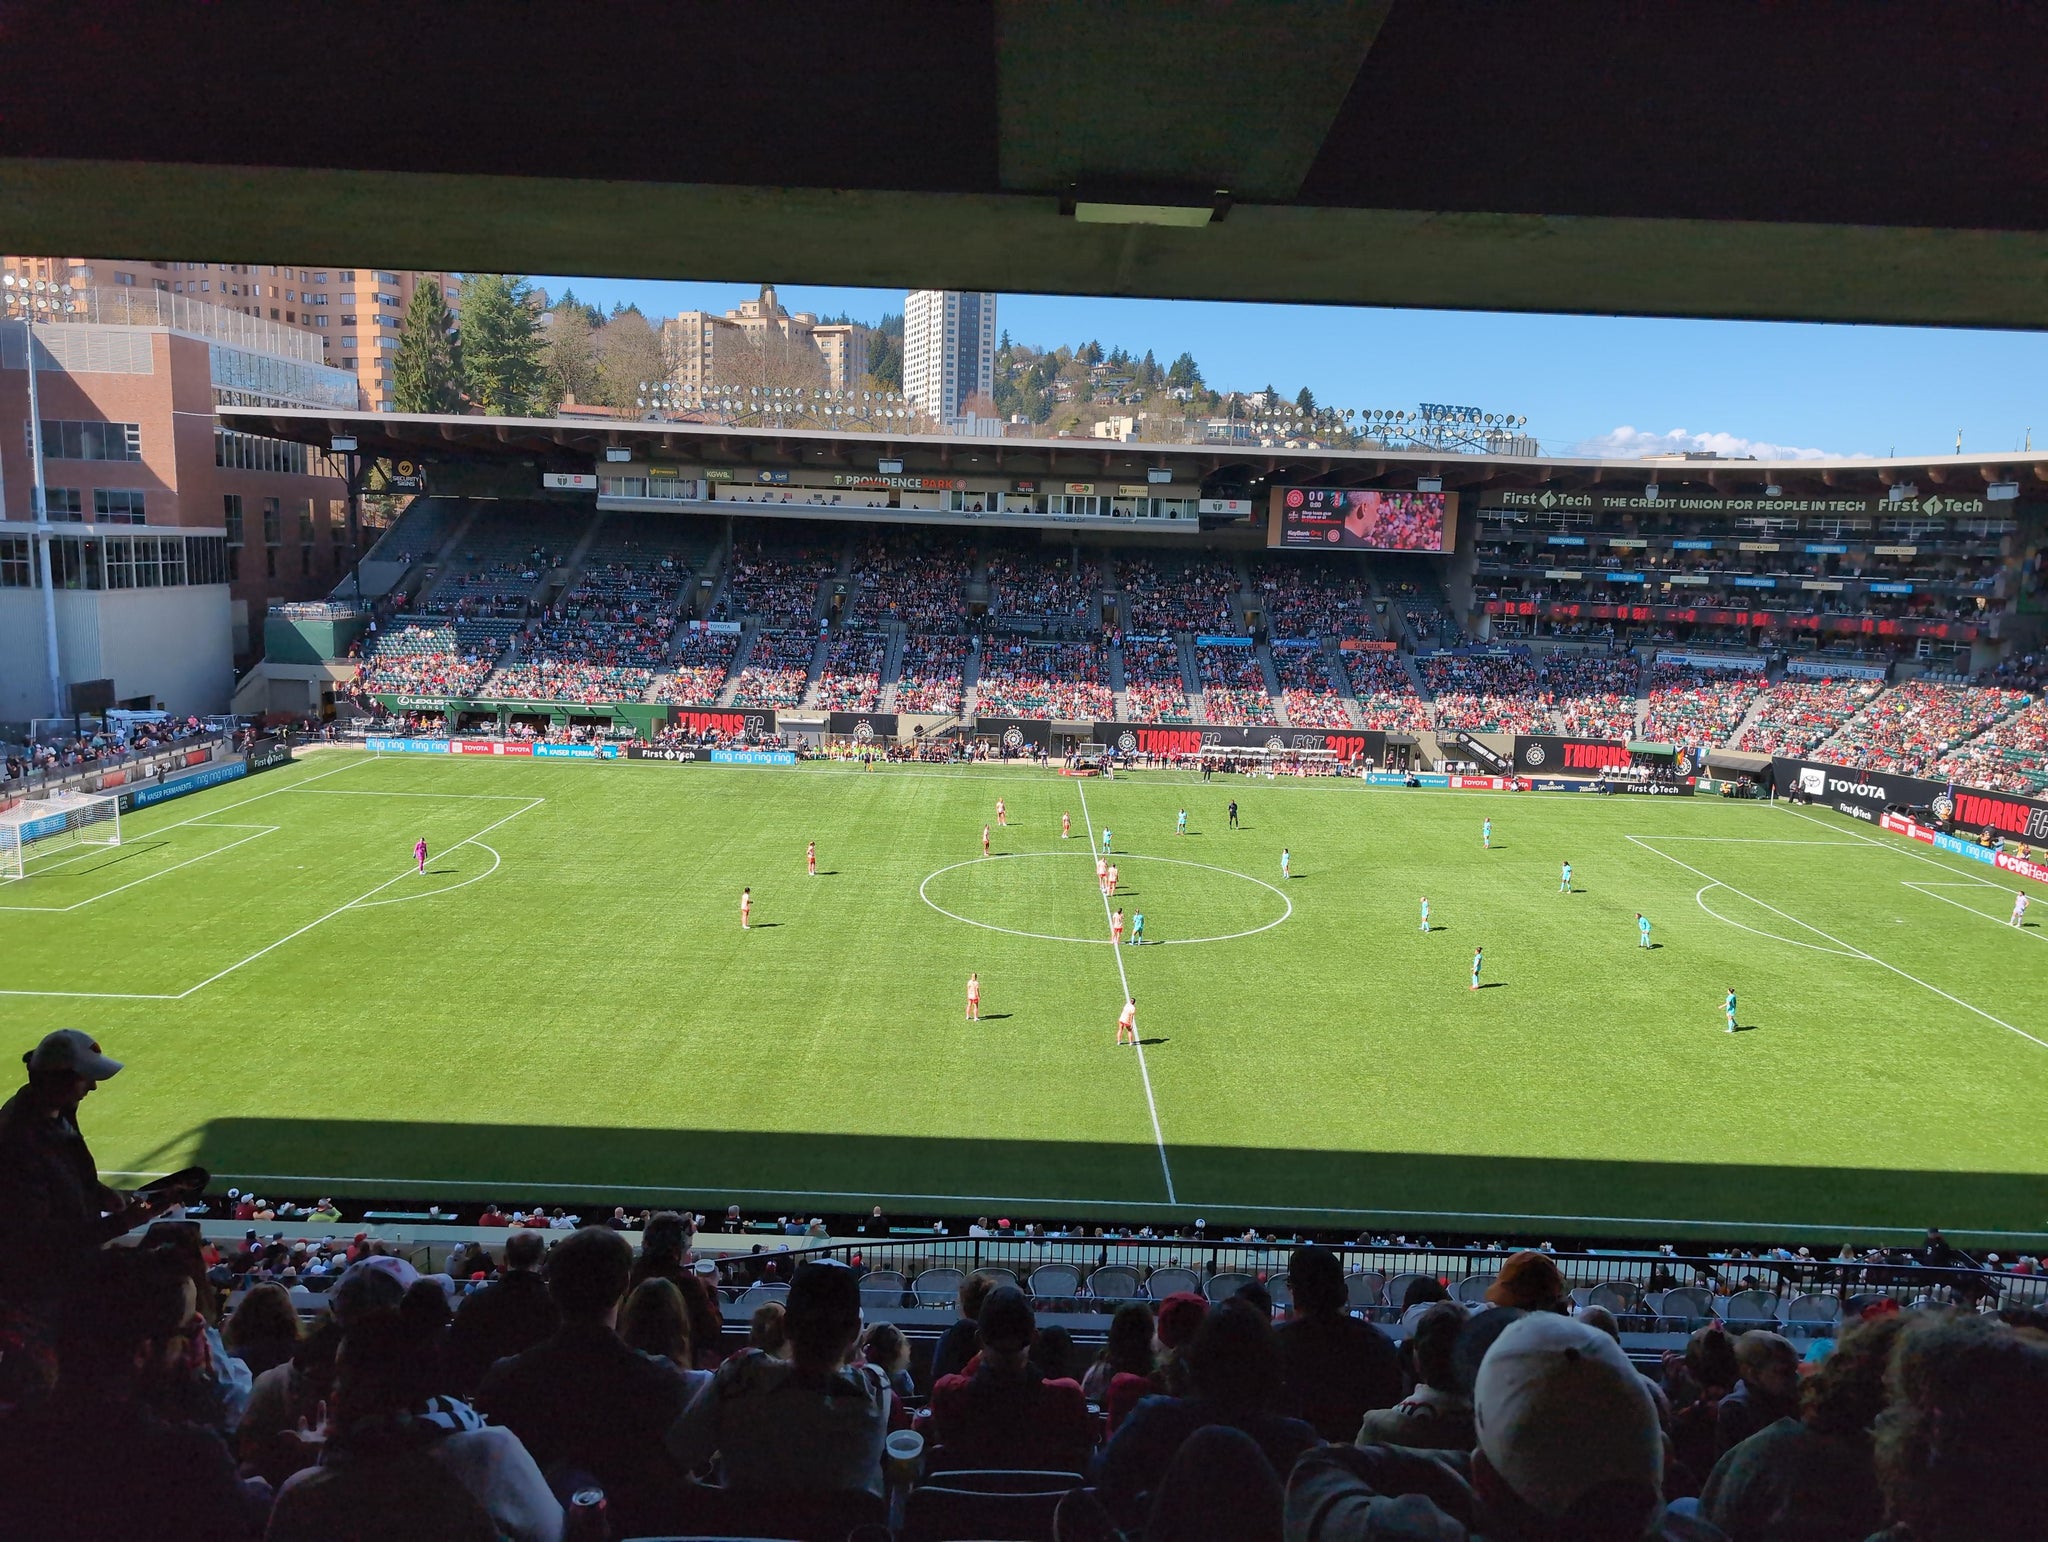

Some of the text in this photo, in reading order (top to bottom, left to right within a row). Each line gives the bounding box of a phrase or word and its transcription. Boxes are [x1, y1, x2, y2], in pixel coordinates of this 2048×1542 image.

[1419, 403, 1483, 422] VOLVO
[845, 475, 954, 490] PROVIDENCE PARK
[1308, 490, 1325, 501] 0 0
[1503, 491, 1592, 507] First Tech
[1602, 497, 1866, 511] THE CREDIT UNION FOR PEOPLE IN TECH
[1878, 498, 1984, 513] First Tech
[678, 711, 745, 737] THORNS
[387, 741, 405, 752] ring
[411, 741, 429, 752] ring
[431, 742, 449, 753] ring
[1137, 729, 1202, 754] THORNS
[1325, 735, 1366, 760] 2012
[254, 752, 285, 768] First Tech
[642, 750, 663, 759] First
[714, 752, 791, 764] ring ring ring ring
[1562, 743, 1633, 769] THORNS
[196, 763, 245, 786] ring ring ring ring
[147, 790, 163, 801] KAISER
[1627, 784, 1679, 794] First Tech
[1828, 778, 1887, 800] TOYOTA
[1839, 802, 1872, 821] First Tech
[1955, 793, 2031, 835] THORNS
[1889, 820, 1907, 832] TOYOTA
[1915, 829, 1933, 840] TOYOTA
[1935, 833, 1995, 865] ring ring ring ring
